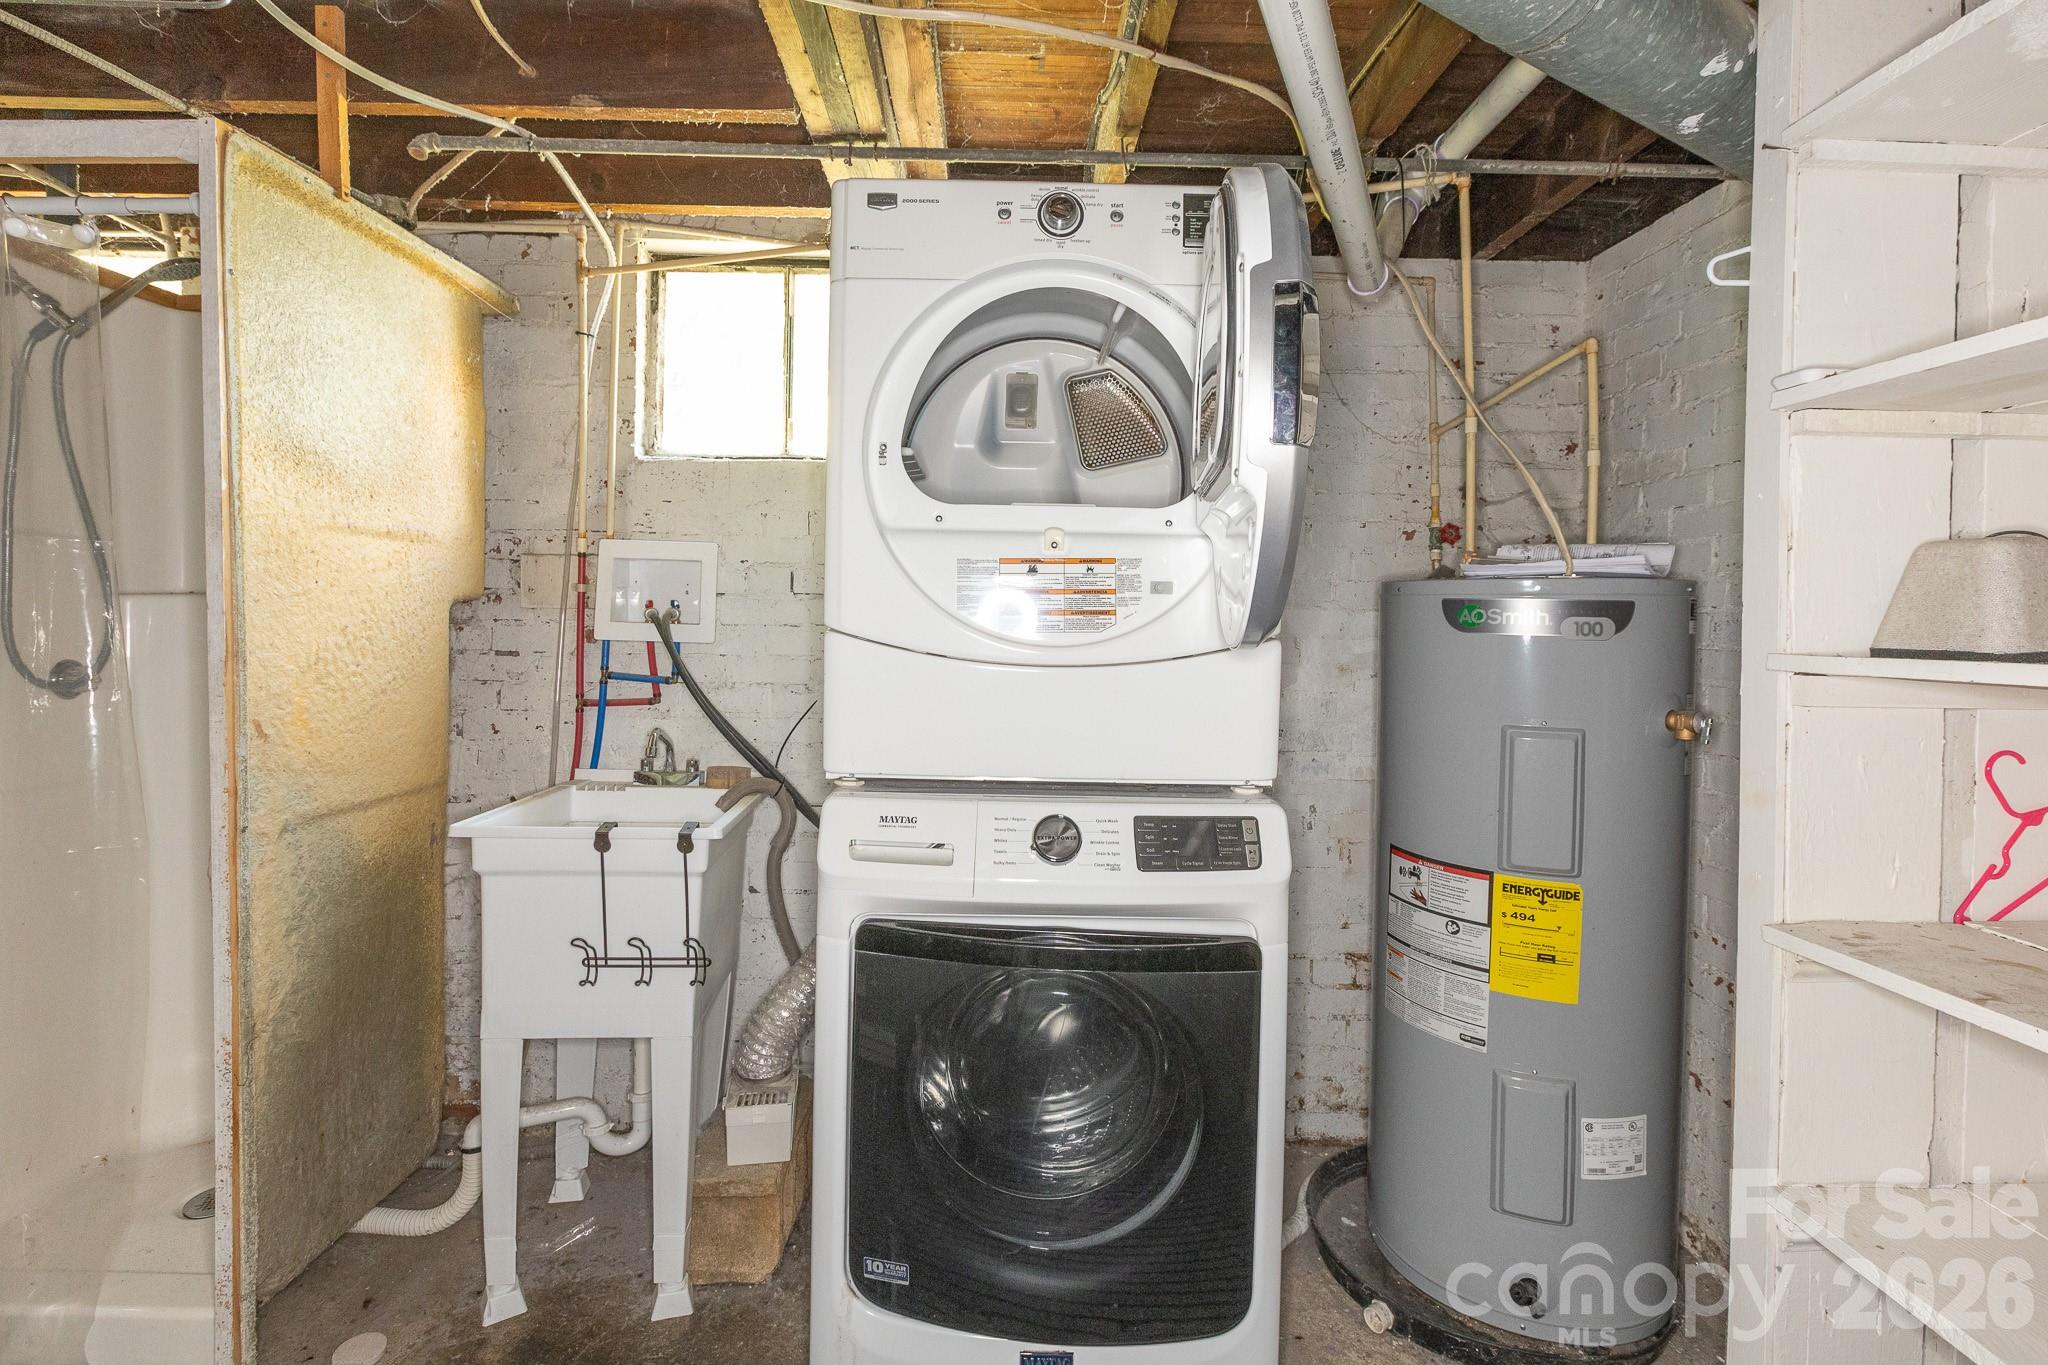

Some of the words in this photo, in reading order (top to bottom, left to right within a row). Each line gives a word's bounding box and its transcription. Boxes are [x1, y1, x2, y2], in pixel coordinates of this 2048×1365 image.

[1574, 621, 1603, 637] 100
[880, 816, 918, 824] MAYTAG
[1424, 862, 1444, 870] DANGER
[1502, 883, 1580, 901] ENERGYGUIDE
[1510, 912, 1535, 922] 494
[866, 1260, 884, 1273] 10
[884, 1262, 906, 1271] YEAR
